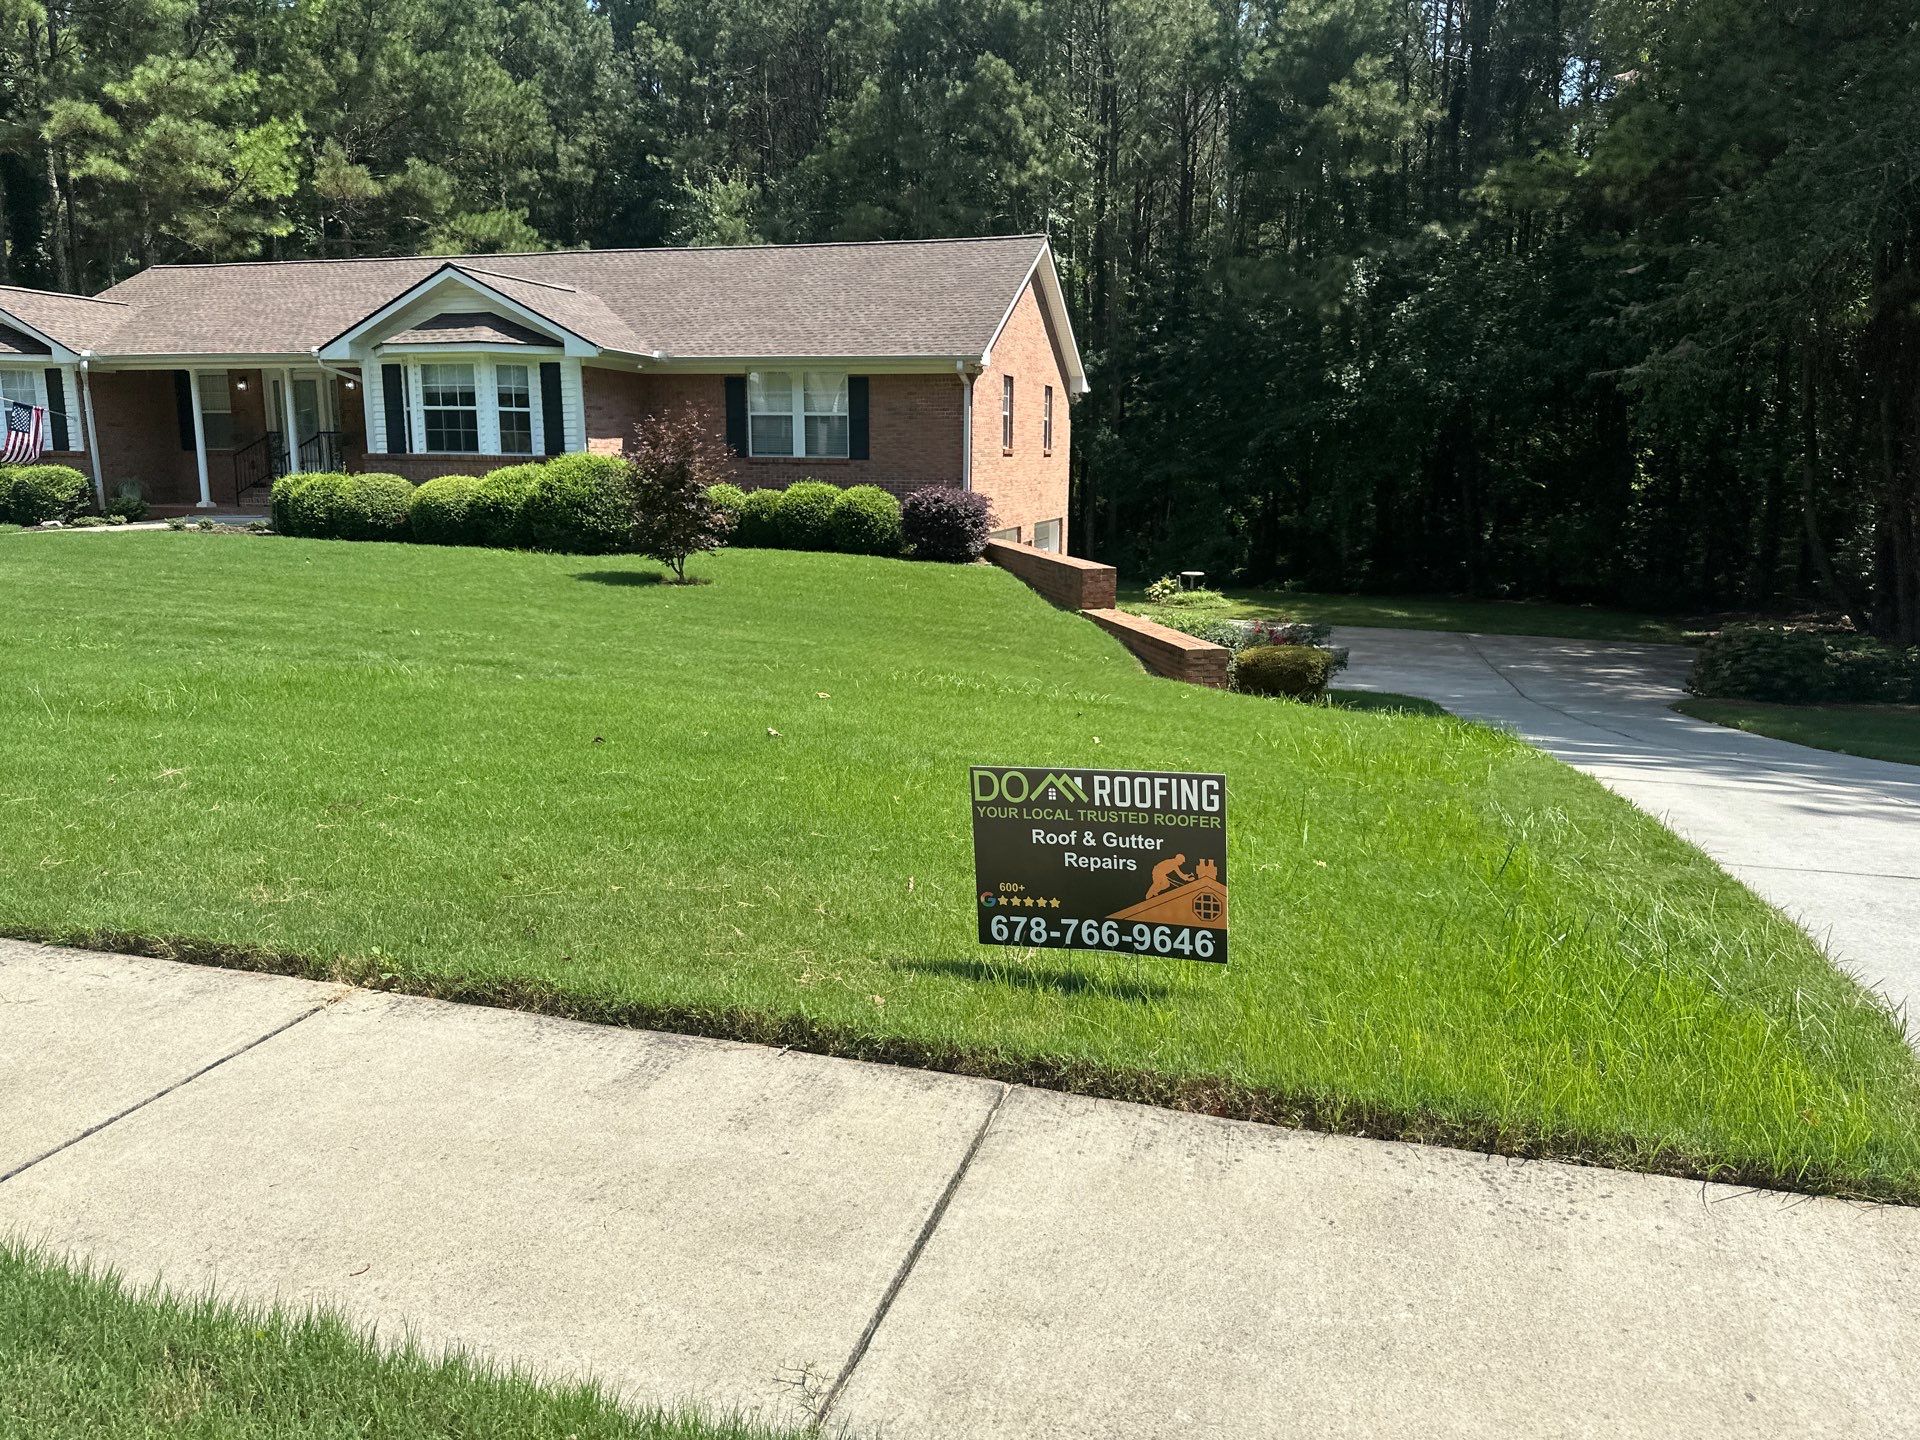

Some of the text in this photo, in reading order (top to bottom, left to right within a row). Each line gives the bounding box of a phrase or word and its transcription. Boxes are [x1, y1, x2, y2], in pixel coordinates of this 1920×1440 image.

[1093, 775, 1220, 812] ROOFING
[977, 806, 1221, 828] YOUR LOCAL TRUSTED ROOFER
[1032, 829, 1164, 850] Roof & Gutter
[1064, 852, 1137, 871] Repairs
[999, 882, 1025, 892] 600+
[990, 915, 1215, 958] 678-766-9646
